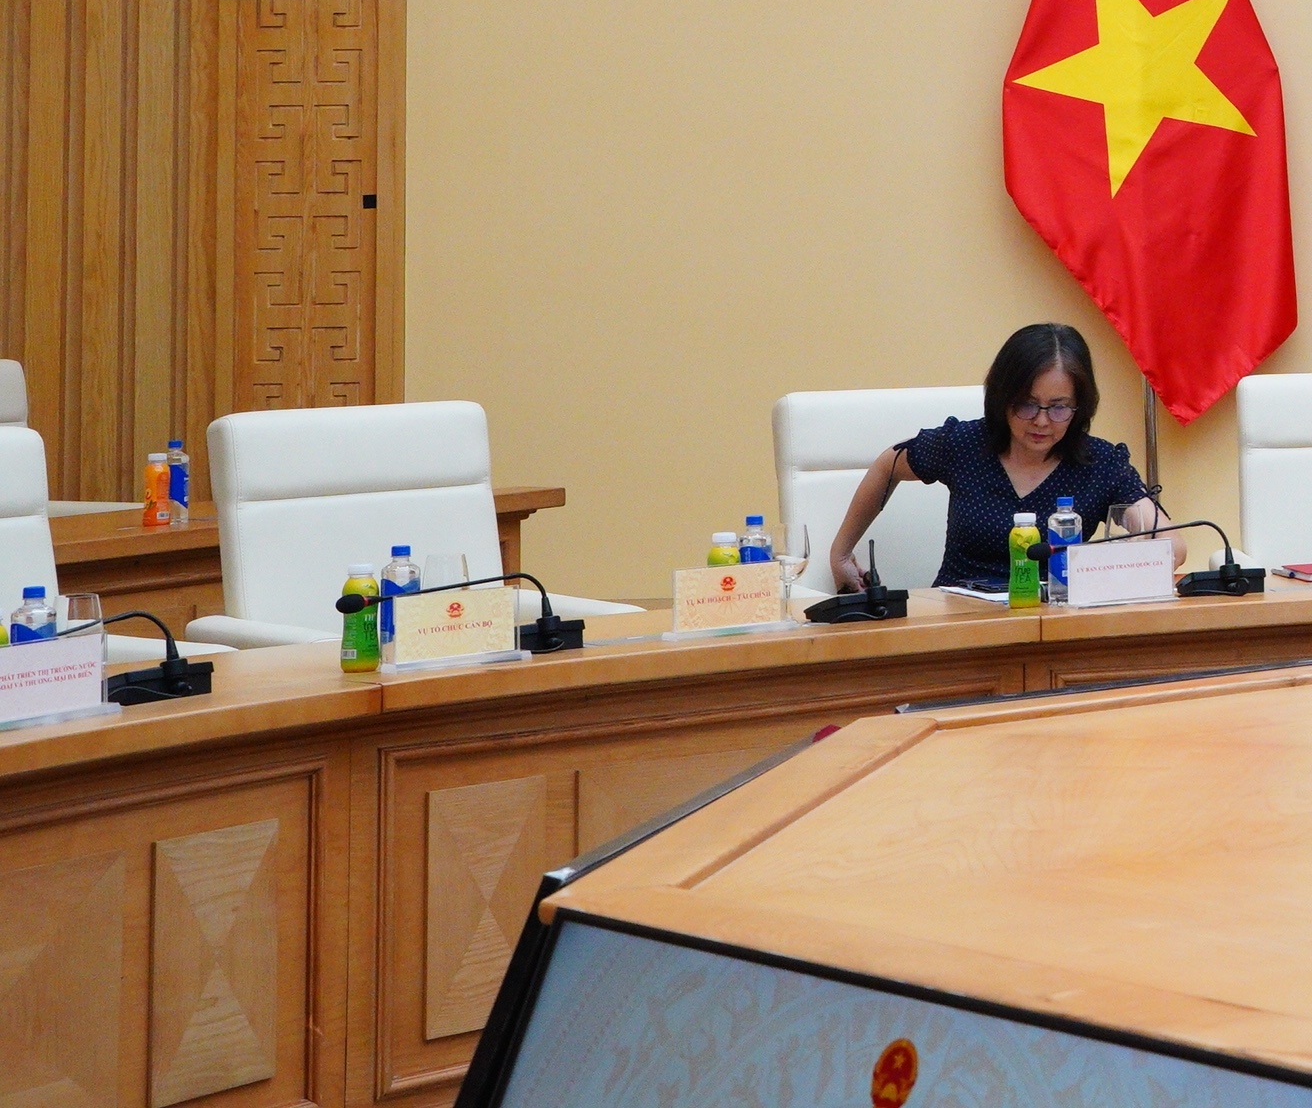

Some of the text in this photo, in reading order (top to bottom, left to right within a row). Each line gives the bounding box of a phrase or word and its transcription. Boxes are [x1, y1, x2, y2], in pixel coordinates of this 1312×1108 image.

[686, 599, 695, 607] VỤ
[418, 628, 427, 636] VỤ
[482, 619, 492, 629] BỘ
